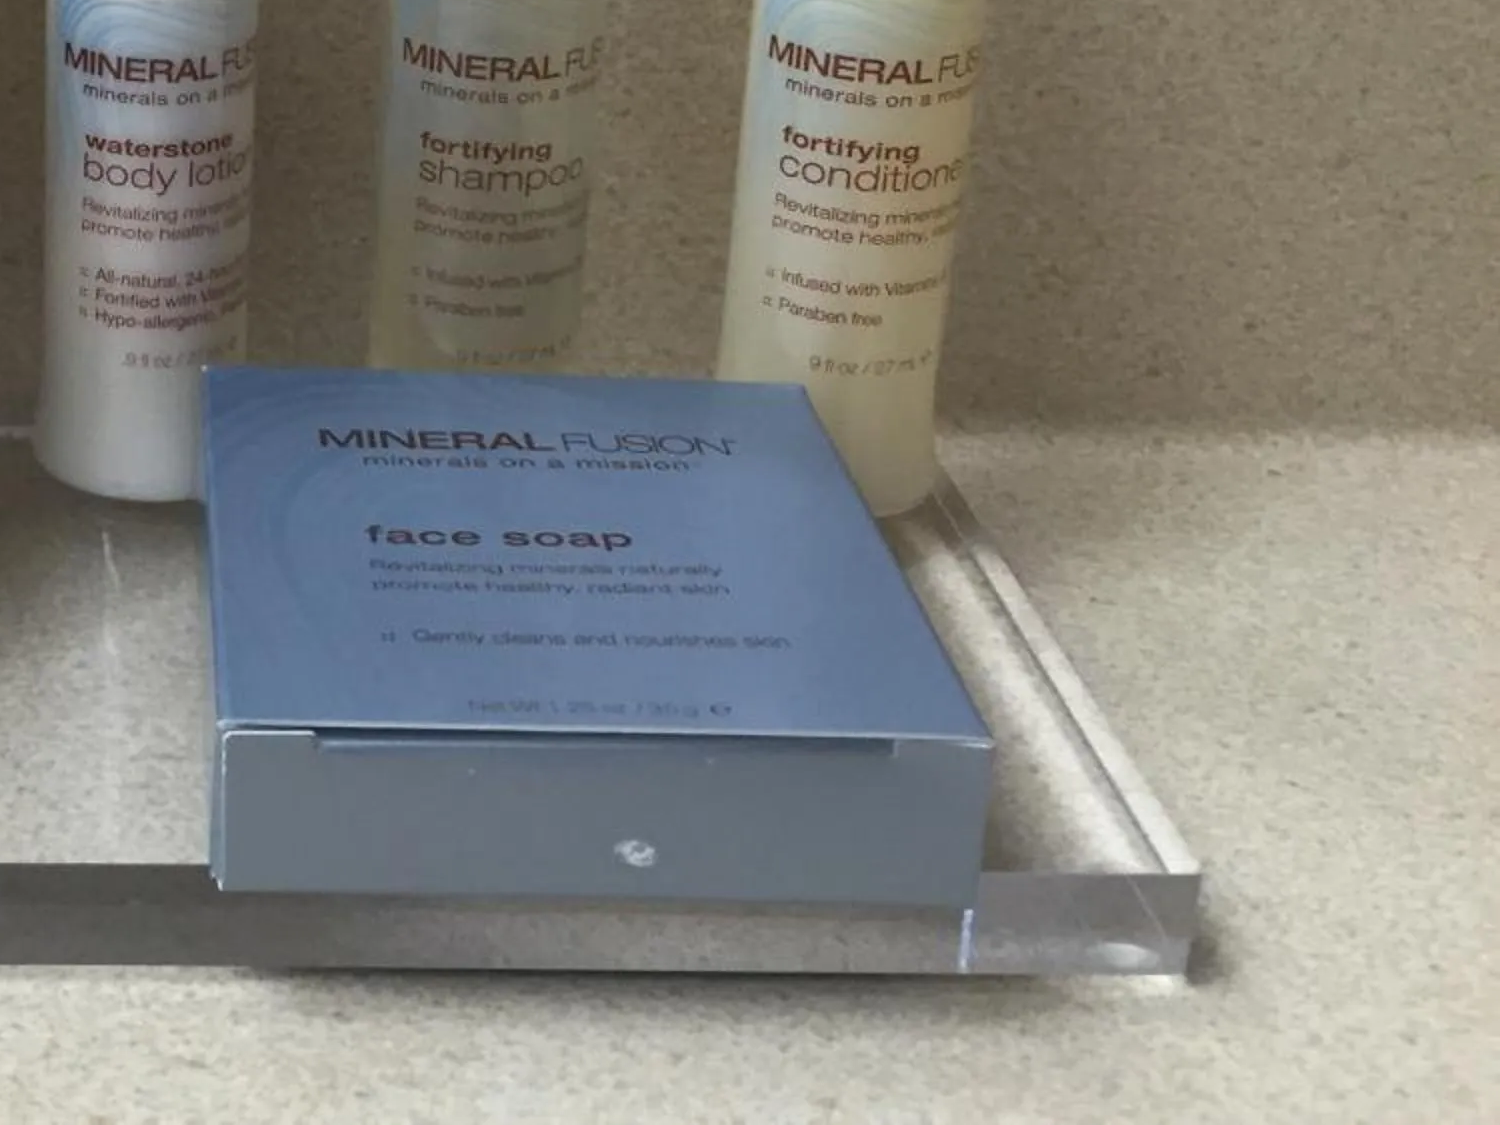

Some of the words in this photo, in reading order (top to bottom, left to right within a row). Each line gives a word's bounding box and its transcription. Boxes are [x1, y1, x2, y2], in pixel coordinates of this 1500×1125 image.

[64, 42, 220, 84] MINERAL
[402, 37, 560, 83] MINERAL
[768, 34, 933, 85] MINERAL
[82, 82, 169, 107] minerals
[176, 91, 201, 106] on
[207, 90, 218, 103] a
[420, 78, 509, 105] minerals
[516, 90, 543, 105] on
[785, 77, 877, 107] minerals
[885, 94, 913, 108] on
[919, 93, 931, 107] a
[85, 133, 234, 159] waterstone
[420, 131, 553, 165] fortifying
[782, 125, 921, 164] fortifying
[83, 152, 177, 196] body
[82, 195, 178, 225] Revitalizing
[774, 191, 881, 226] Revitalizing
[81, 218, 154, 241] promote
[771, 214, 854, 244] promote
[781, 267, 842, 295] Infused
[845, 283, 881, 297] with
[95, 287, 161, 310] Fortified
[778, 296, 849, 326] Paraben
[318, 427, 558, 453] MINERAL
[560, 431, 729, 456] FUSION
[362, 453, 488, 470] minerals
[500, 458, 536, 470] on
[548, 459, 564, 470] a
[576, 457, 690, 473] mission
[364, 523, 482, 547] face
[503, 529, 634, 553] soap
[369, 558, 504, 576] Revitalizing
[509, 561, 614, 576] minerals
[618, 562, 723, 578] naturally
[370, 579, 479, 595] promote
[586, 581, 673, 595] radiant
[680, 582, 730, 595] skin
[411, 628, 486, 647] Gently
[573, 631, 619, 648] and
[623, 632, 738, 649] nourishes
